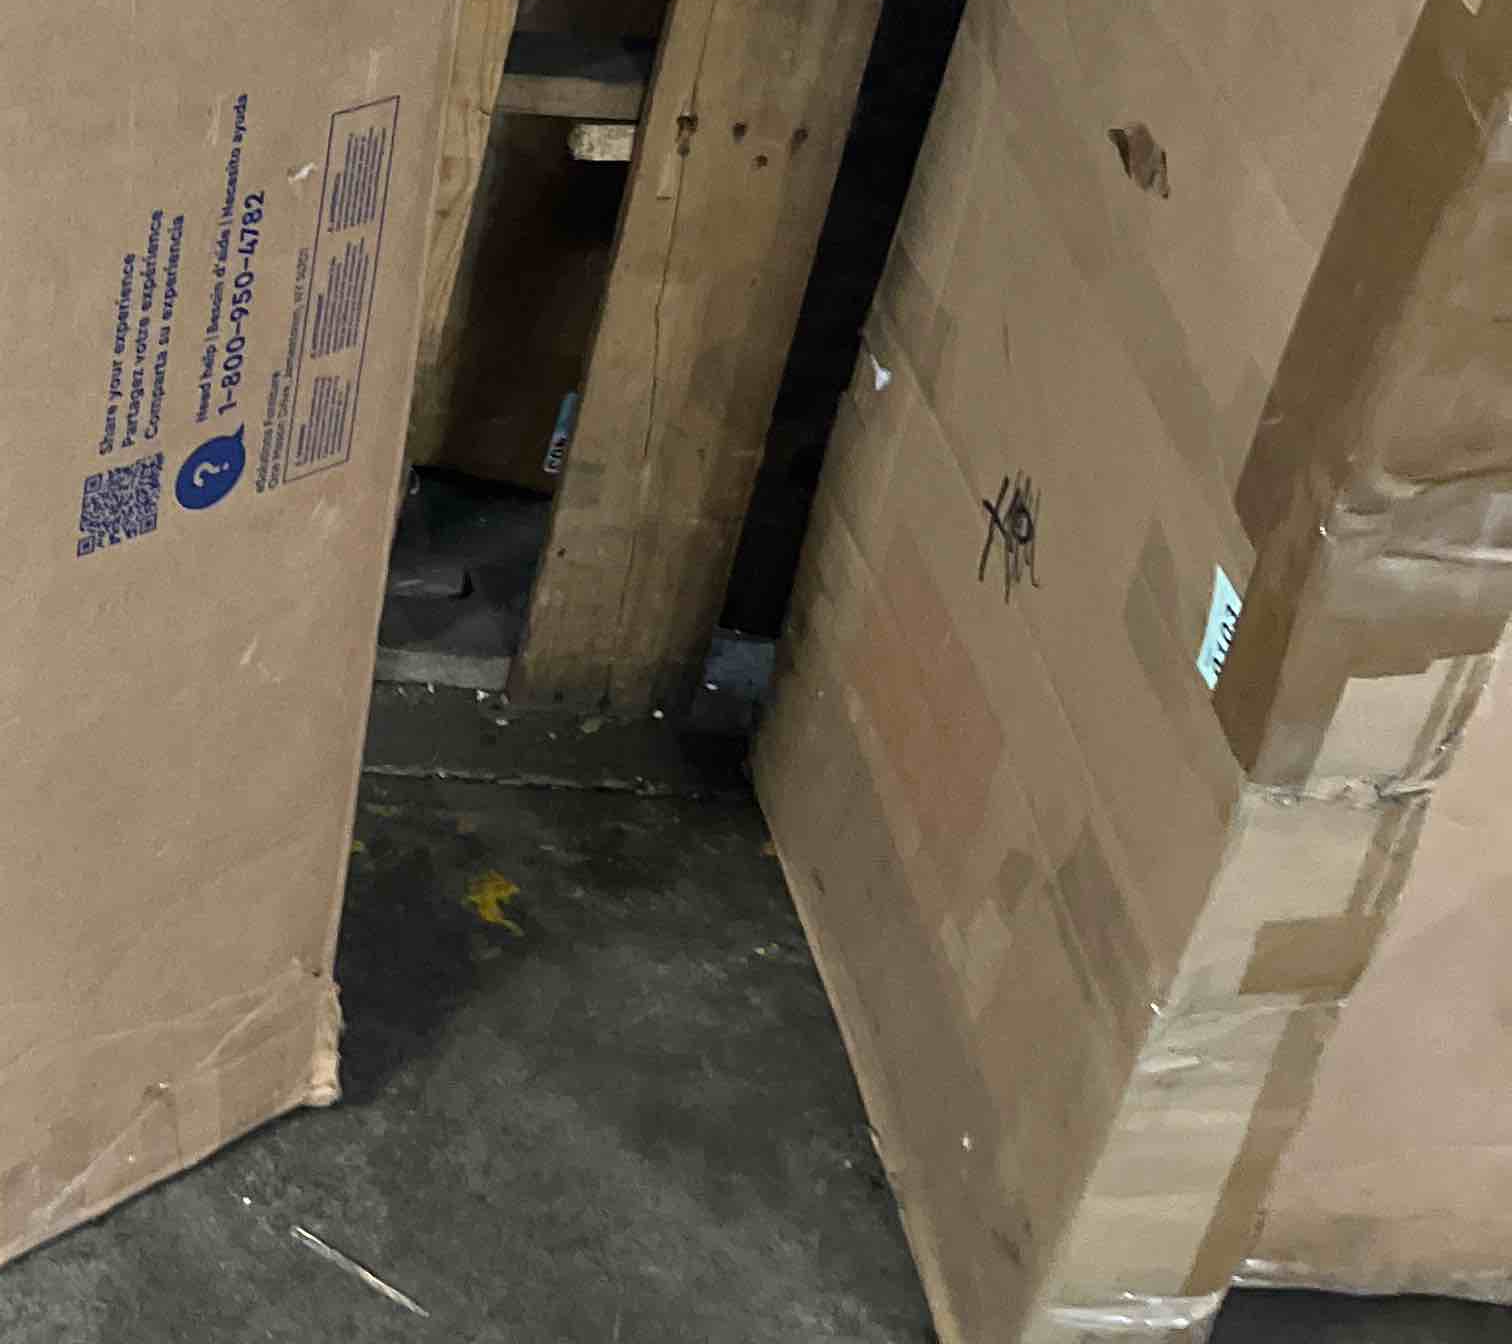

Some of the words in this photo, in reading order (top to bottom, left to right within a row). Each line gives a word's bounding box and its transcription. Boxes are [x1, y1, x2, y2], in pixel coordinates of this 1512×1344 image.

[231, 94, 248, 143] ayuda
[141, 210, 163, 312] expérience
[162, 214, 184, 320] experiencia
[114, 253, 136, 354] experience
[135, 317, 150, 361] votre
[159, 325, 171, 345] su
[218, 190, 265, 416] 1-800-950-4782
[108, 360, 126, 403] your
[122, 365, 144, 447] Partagez
[144, 351, 168, 440] Comparta
[99, 405, 118, 454] Share
